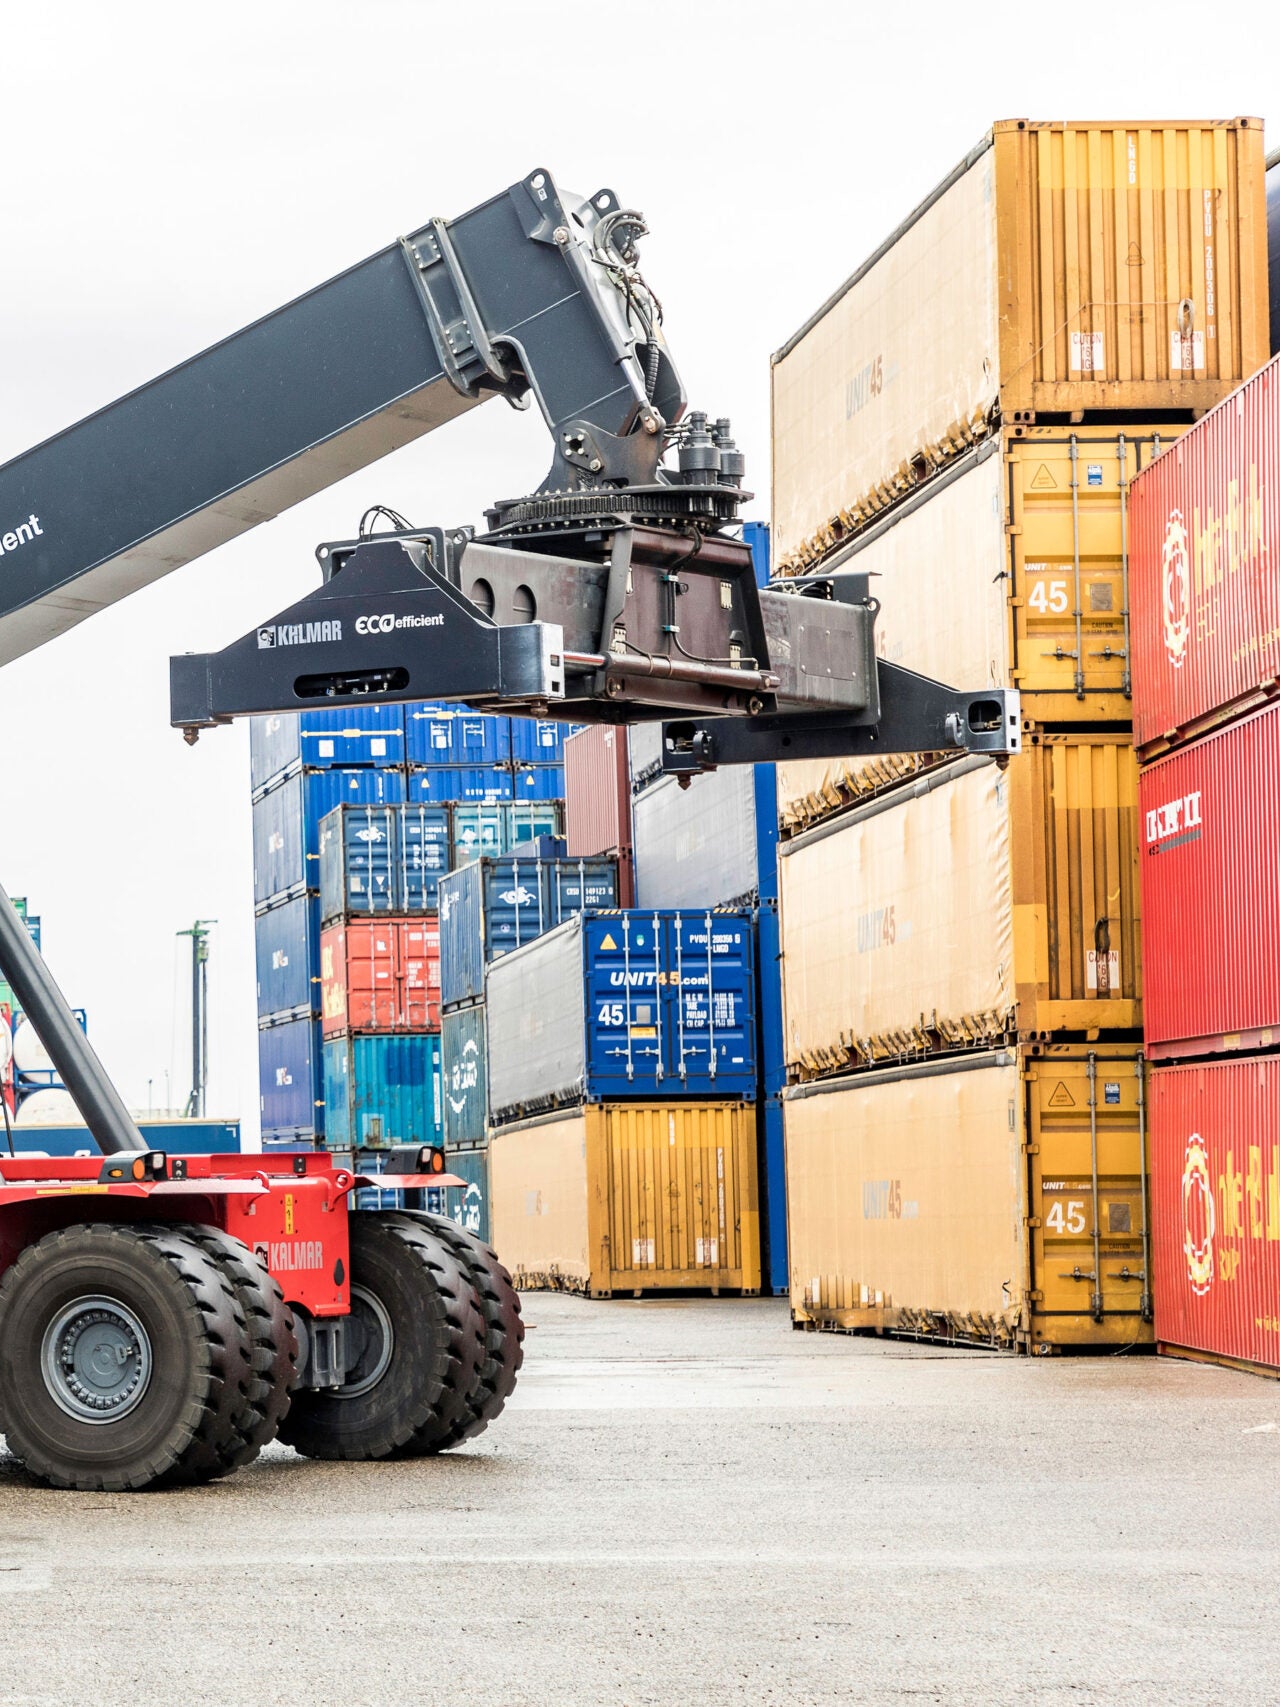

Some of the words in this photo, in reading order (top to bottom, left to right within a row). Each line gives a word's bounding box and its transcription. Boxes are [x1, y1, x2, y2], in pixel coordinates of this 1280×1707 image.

[1028, 580, 1068, 613] 45
[277, 619, 343, 646] KALMAR
[394, 613, 445, 629] efficient
[598, 1004, 625, 1026] 45
[1045, 1201, 1086, 1234] 45
[270, 1241, 324, 1271] KALMAR
